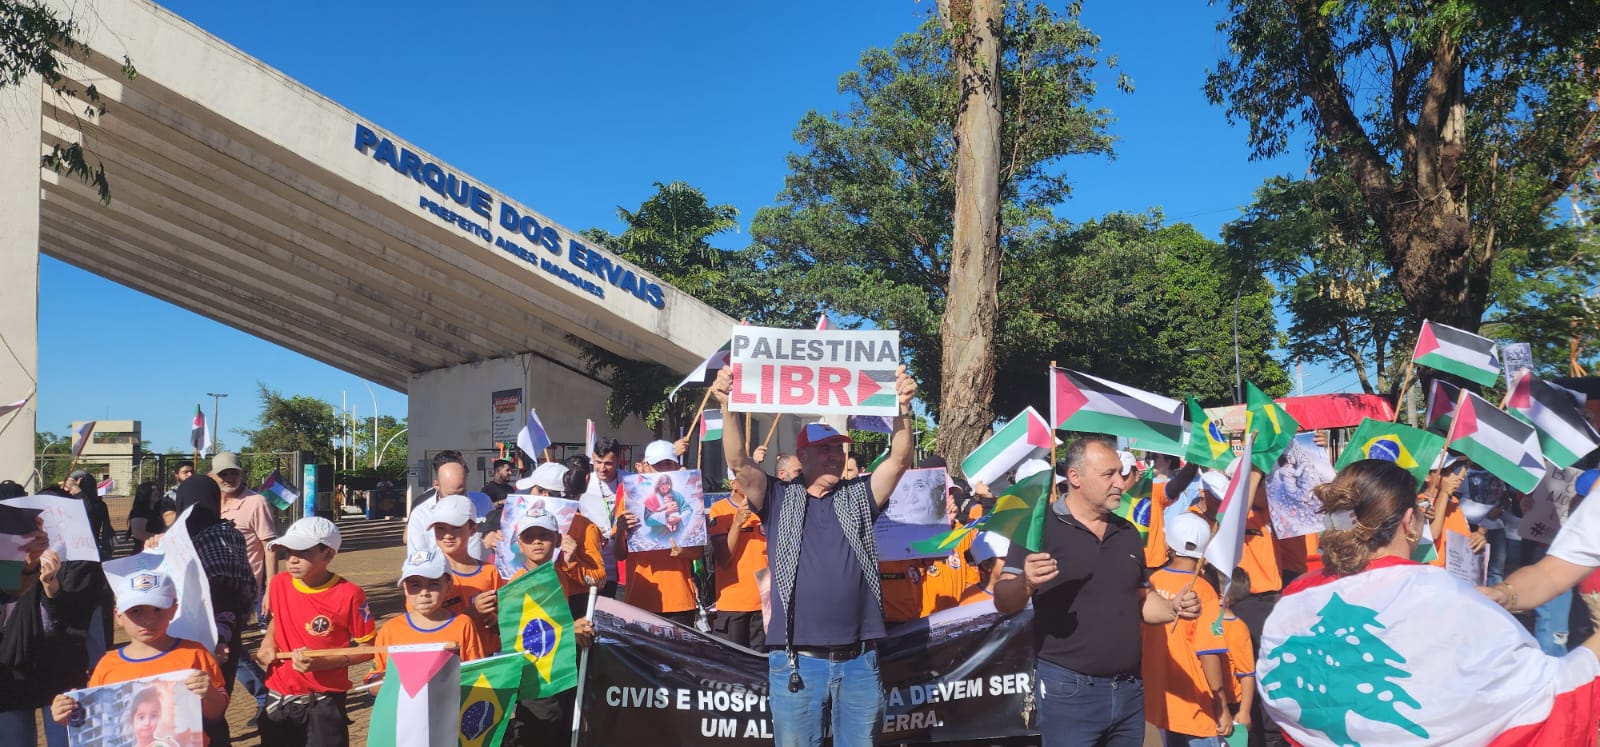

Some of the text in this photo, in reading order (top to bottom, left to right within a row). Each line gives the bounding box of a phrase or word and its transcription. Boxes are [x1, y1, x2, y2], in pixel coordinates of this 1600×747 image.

[354, 122, 665, 309] PARQUE DOS ERVAIS
[419, 195, 604, 298] PREFEITO AIRES MARQUES
[733, 335, 896, 362] PALESTINA
[606, 685, 770, 712] CIVIS E HOSPI
[910, 677, 982, 705] DEVEM
[989, 672, 1032, 696] SER
[701, 718, 774, 738] UM AL
[881, 710, 944, 734] ERRA.
